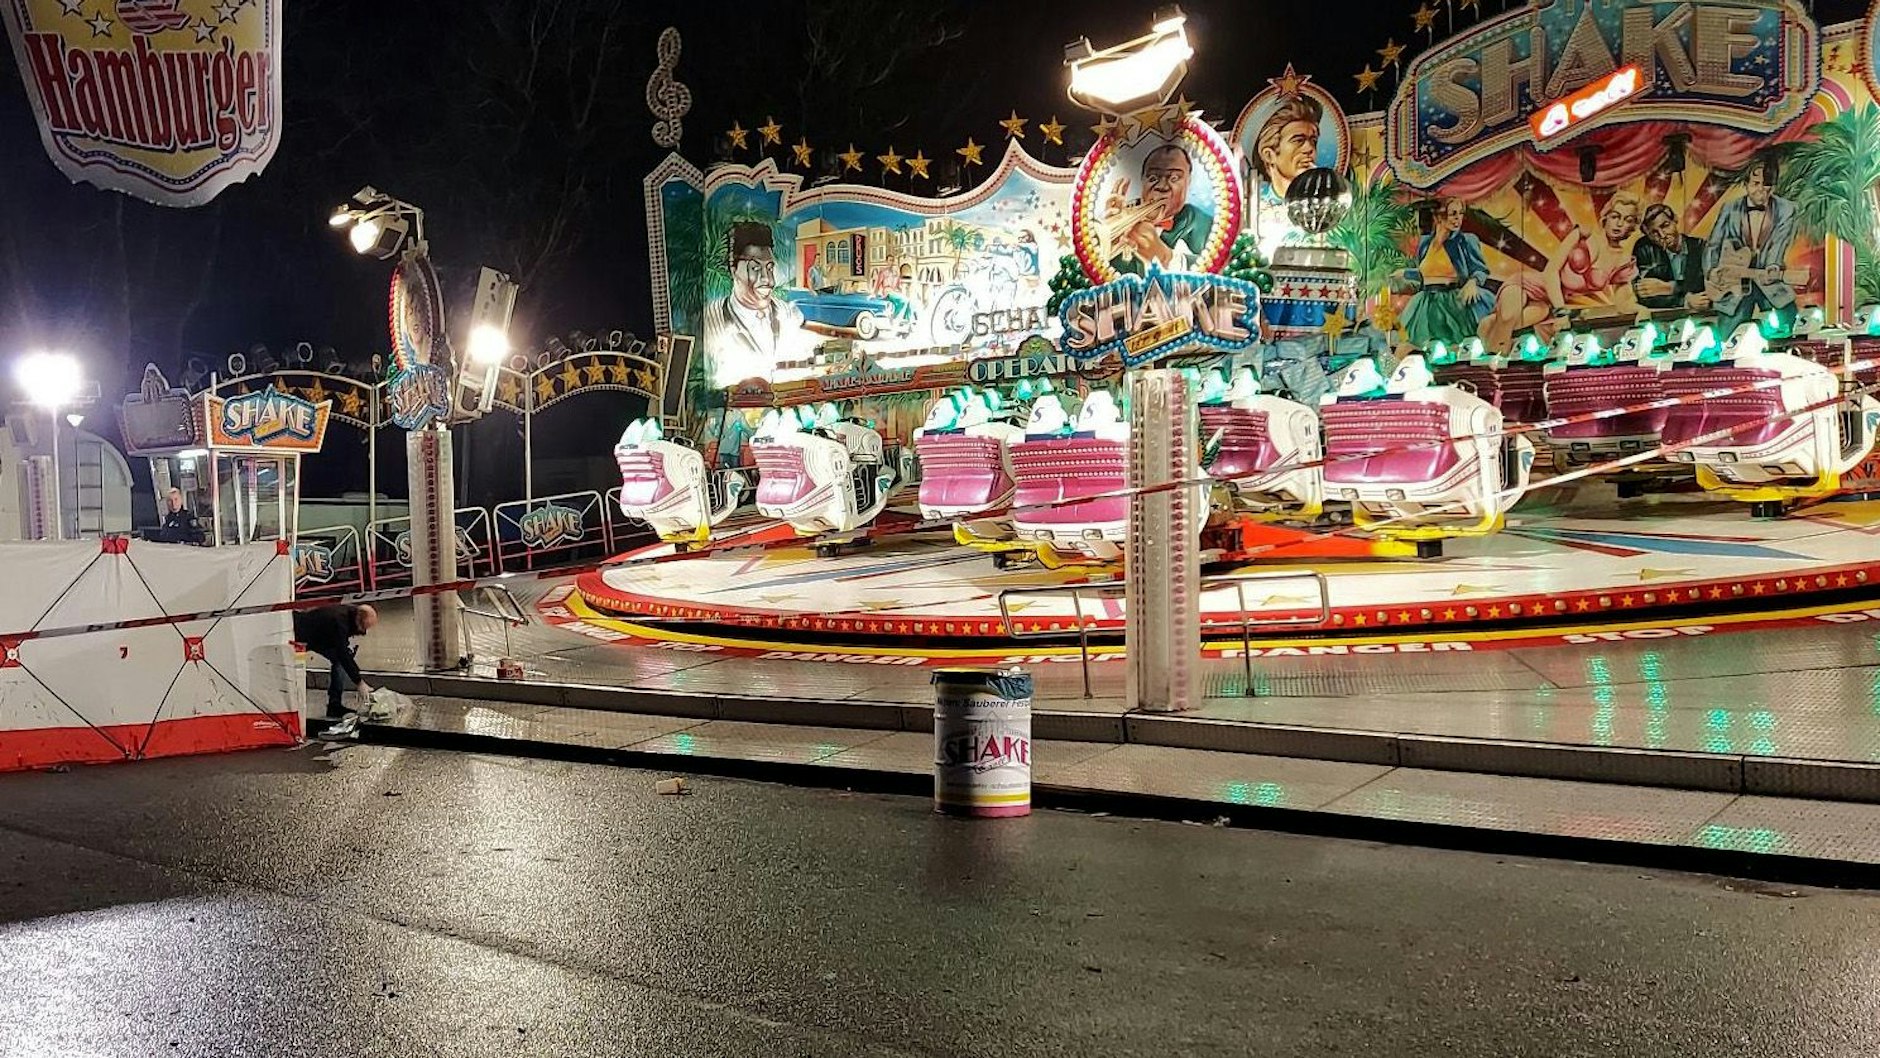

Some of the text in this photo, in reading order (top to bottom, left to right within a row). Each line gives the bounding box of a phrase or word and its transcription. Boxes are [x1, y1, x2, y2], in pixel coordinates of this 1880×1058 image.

[1427, 1, 1764, 144] SHAKE
[24, 31, 271, 152] Hamburger
[1065, 275, 1251, 349] SHAKE
[226, 397, 312, 436] SHAKE
[523, 511, 581, 540] SHAKE
[1221, 642, 1473, 658] DANGER
[1561, 626, 1714, 644] STOP
[757, 652, 928, 666] DANGER
[945, 734, 1029, 766] SHAKE
